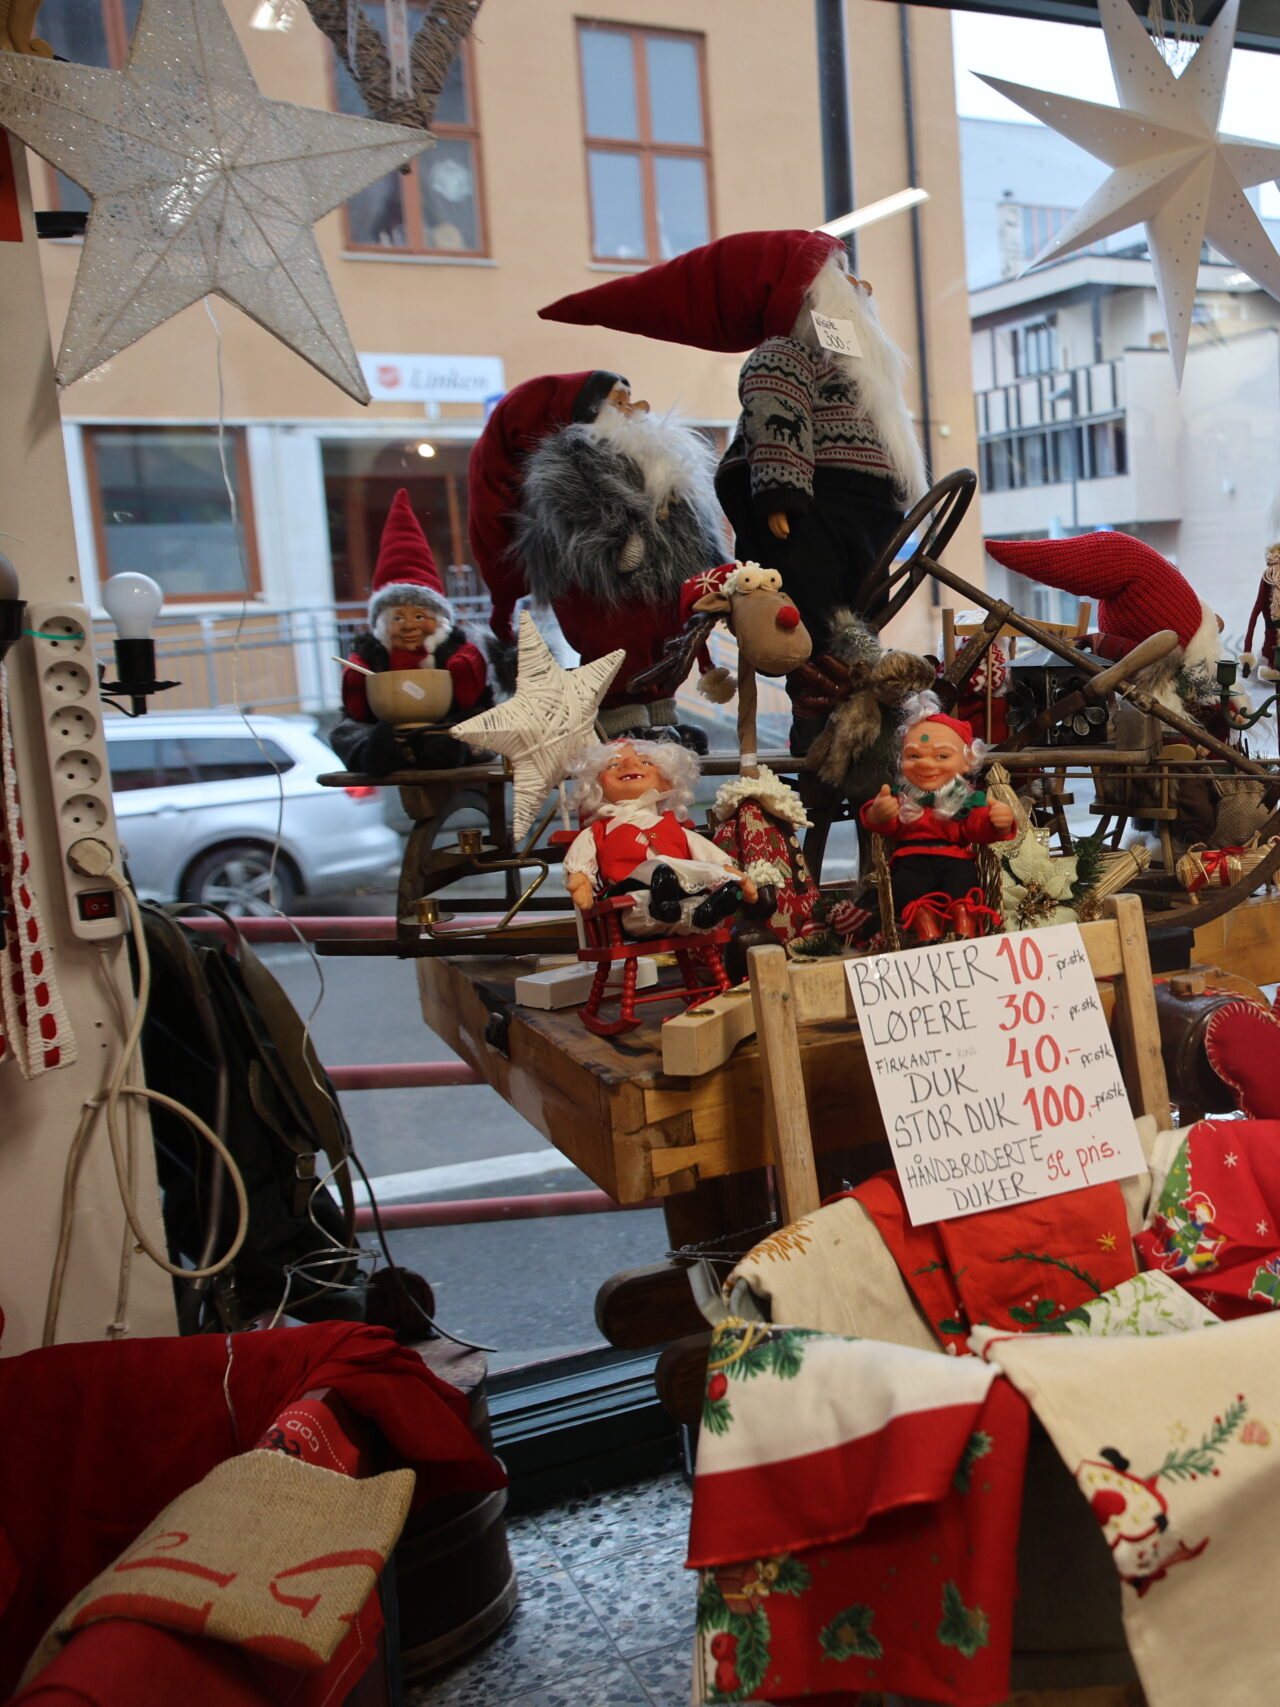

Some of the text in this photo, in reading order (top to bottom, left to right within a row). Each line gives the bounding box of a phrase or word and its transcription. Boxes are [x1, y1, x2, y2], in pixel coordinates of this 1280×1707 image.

[851, 944, 999, 1006] BRIKKER
[867, 998, 978, 1046] LØPERE
[903, 1064, 979, 1104] DUK
[894, 1102, 964, 1149] STOR
[964, 1092, 1019, 1135] DUK
[946, 1170, 1038, 1212] DUKER
